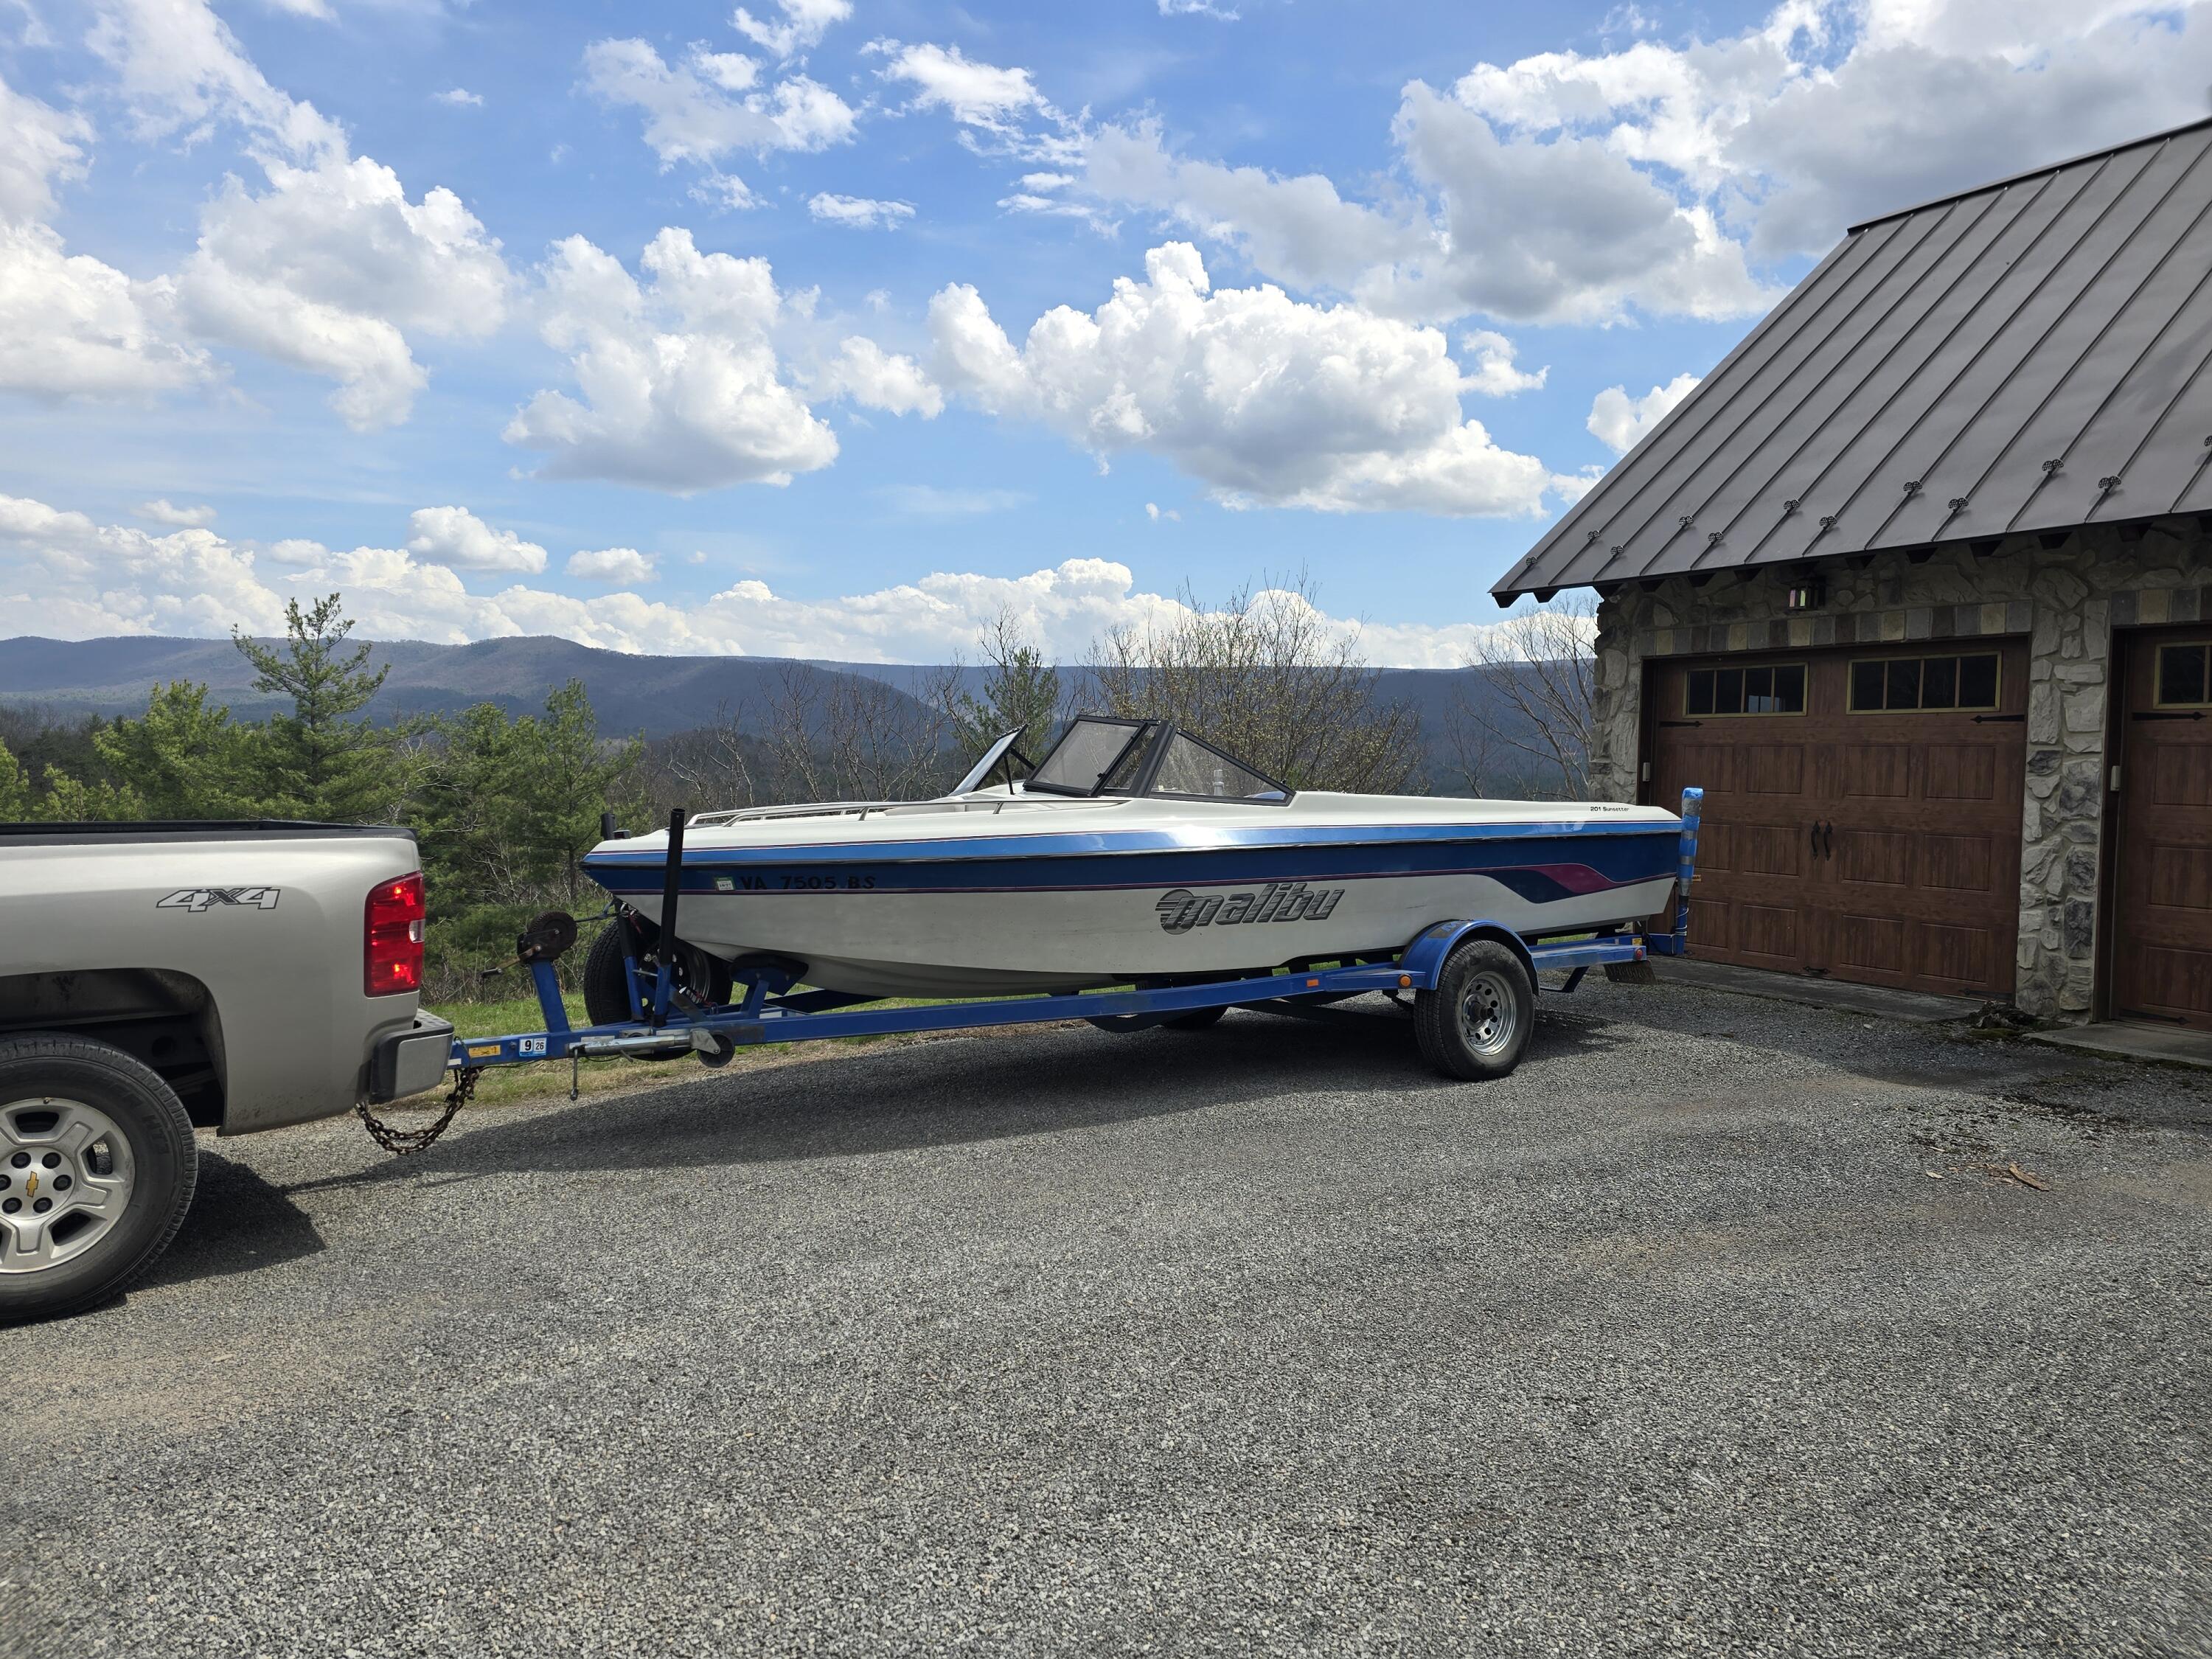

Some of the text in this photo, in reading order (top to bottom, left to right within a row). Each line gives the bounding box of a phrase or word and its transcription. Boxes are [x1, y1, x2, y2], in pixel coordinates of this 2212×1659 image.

[740, 876, 876, 889] VA 7505 BS
[524, 1040, 544, 1051] 9 26
